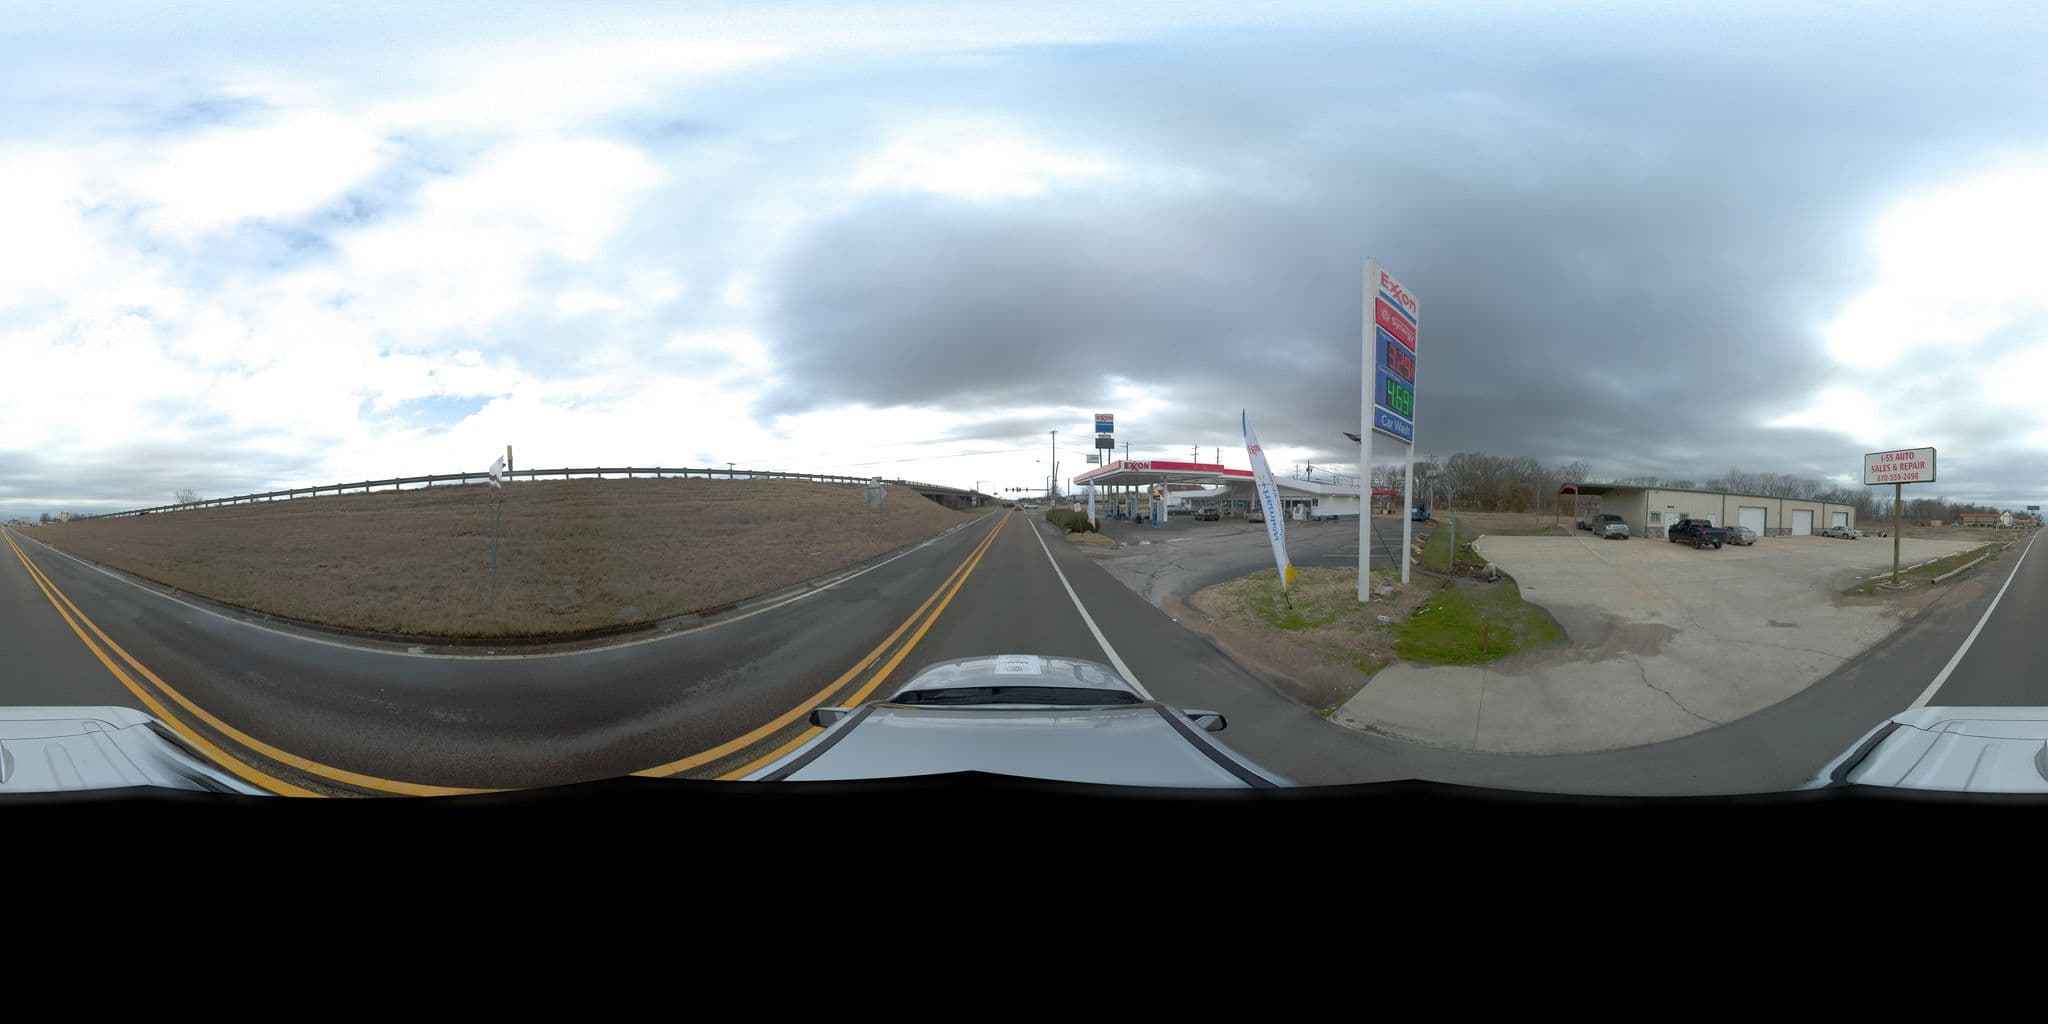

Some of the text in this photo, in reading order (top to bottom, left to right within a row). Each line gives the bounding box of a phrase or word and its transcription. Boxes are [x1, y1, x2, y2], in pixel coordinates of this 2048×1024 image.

[1381, 414, 1411, 436] Car Wash
[1896, 452, 1914, 461] AUTO
[1871, 464, 1891, 473] SALES
[1900, 461, 1925, 471] REPAIR
